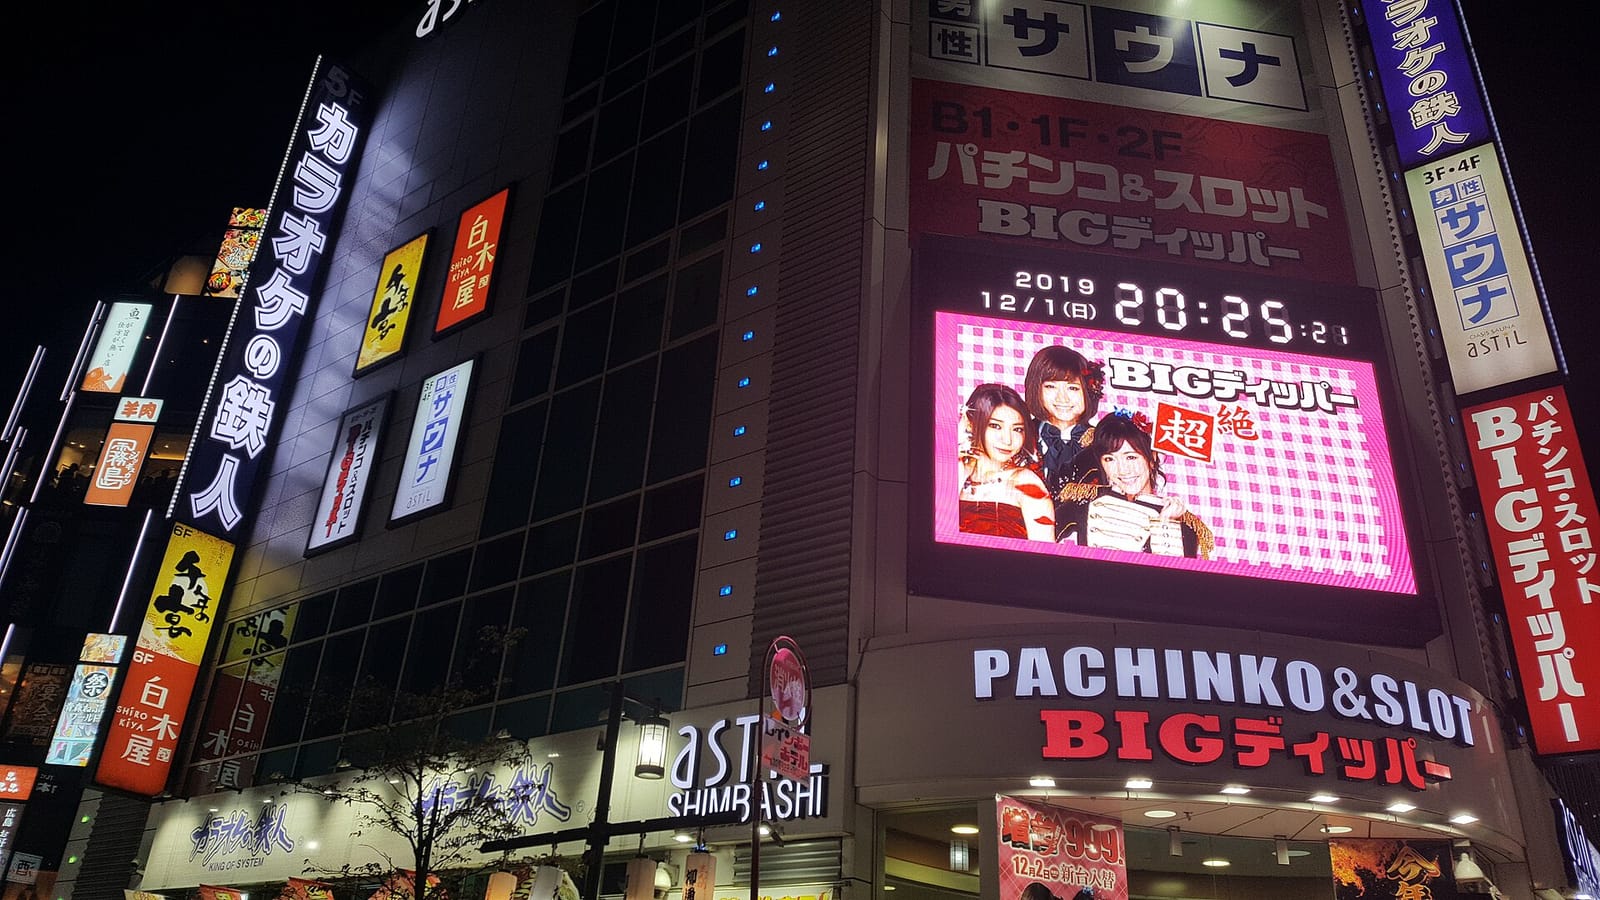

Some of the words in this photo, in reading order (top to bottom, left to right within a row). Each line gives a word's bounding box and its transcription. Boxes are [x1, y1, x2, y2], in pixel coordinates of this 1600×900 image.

[1002, 7, 1282, 88] サウナ
[1380, 0, 1470, 156] ラオケの鉄人
[928, 141, 1329, 229] パチンコ&スロット
[1434, 179, 1480, 205] 男性
[452, 214, 496, 311] 白木屋
[977, 199, 1300, 267] BIGディッパー
[1440, 199, 1508, 324] サウナ
[190, 101, 359, 532] カラオケの鉄人
[1015, 271, 1095, 295] 2019
[121, 400, 157, 419] 羊肉
[1107, 356, 1360, 415] BIGディッパー
[417, 390, 453, 483] サウナ
[1158, 404, 1260, 460] 超絶
[173, 525, 193, 538] 6F
[1527, 394, 1600, 605] パチンコ・スロット
[1471, 405, 1585, 743] BIGディッパー
[84, 673, 107, 697] 祭
[132, 650, 155, 664] 6F
[120, 675, 180, 768] 白木屋
[1040, 709, 1453, 791] BIGディッパー
[189, 802, 294, 865] カラオケの鉄人
[208, 861, 226, 872] KING
[226, 860, 236, 870] OF
[236, 857, 265, 870] SYSTEM
